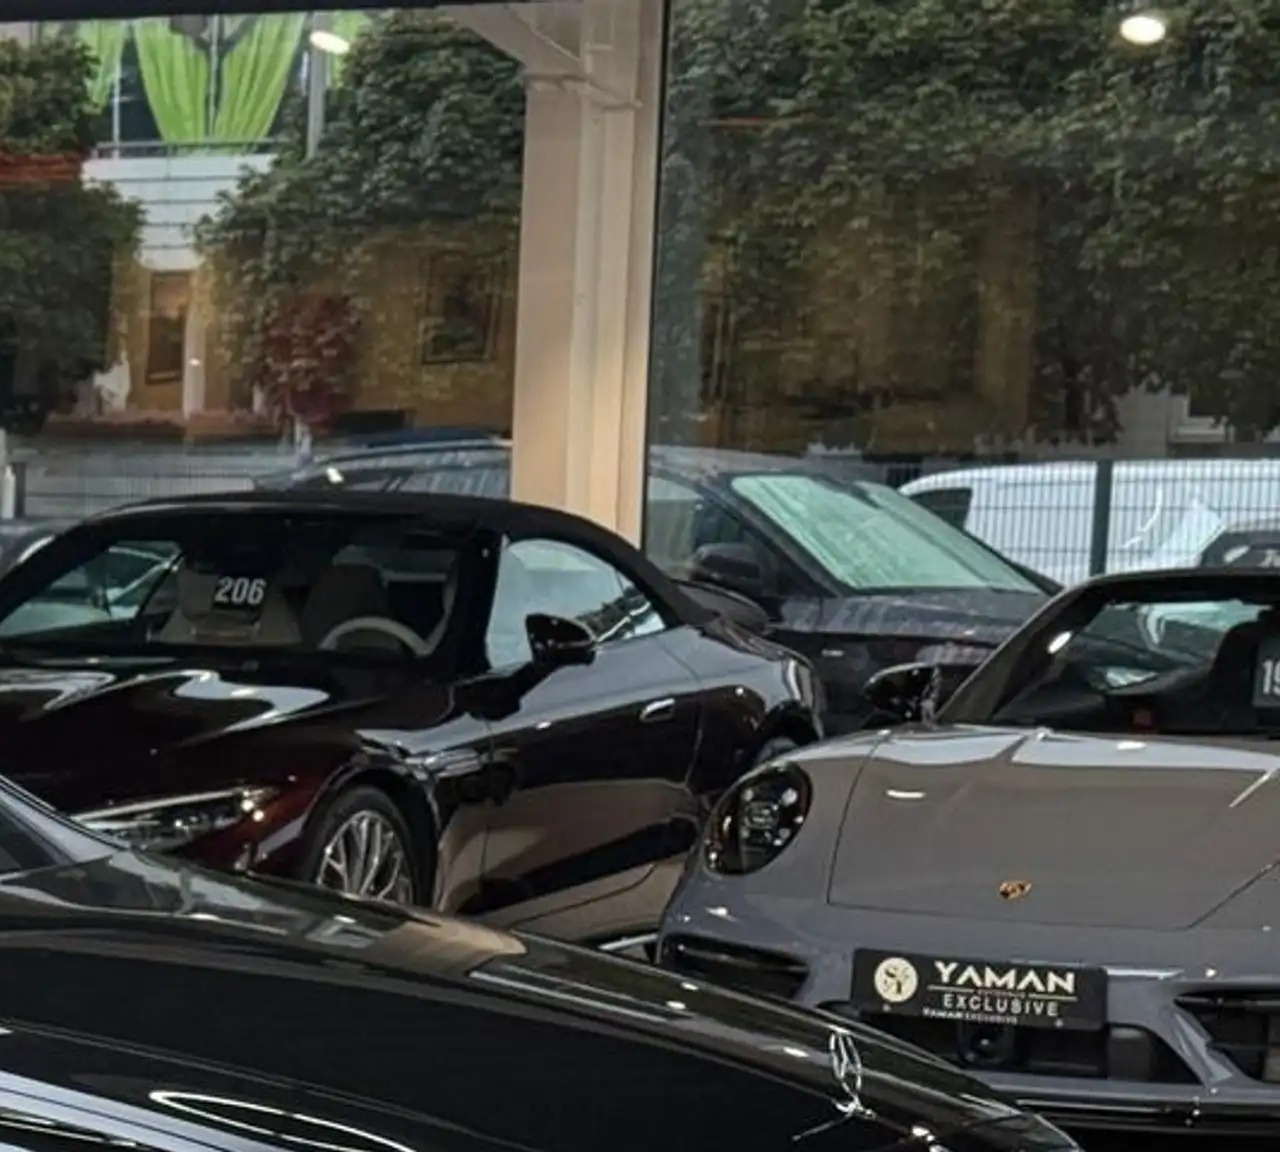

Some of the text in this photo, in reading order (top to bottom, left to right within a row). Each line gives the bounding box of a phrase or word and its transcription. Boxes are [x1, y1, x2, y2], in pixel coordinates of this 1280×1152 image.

[214, 576, 267, 605] 206
[934, 960, 1076, 994] YAMAN
[943, 993, 1060, 1017] EXCLUSIVE
